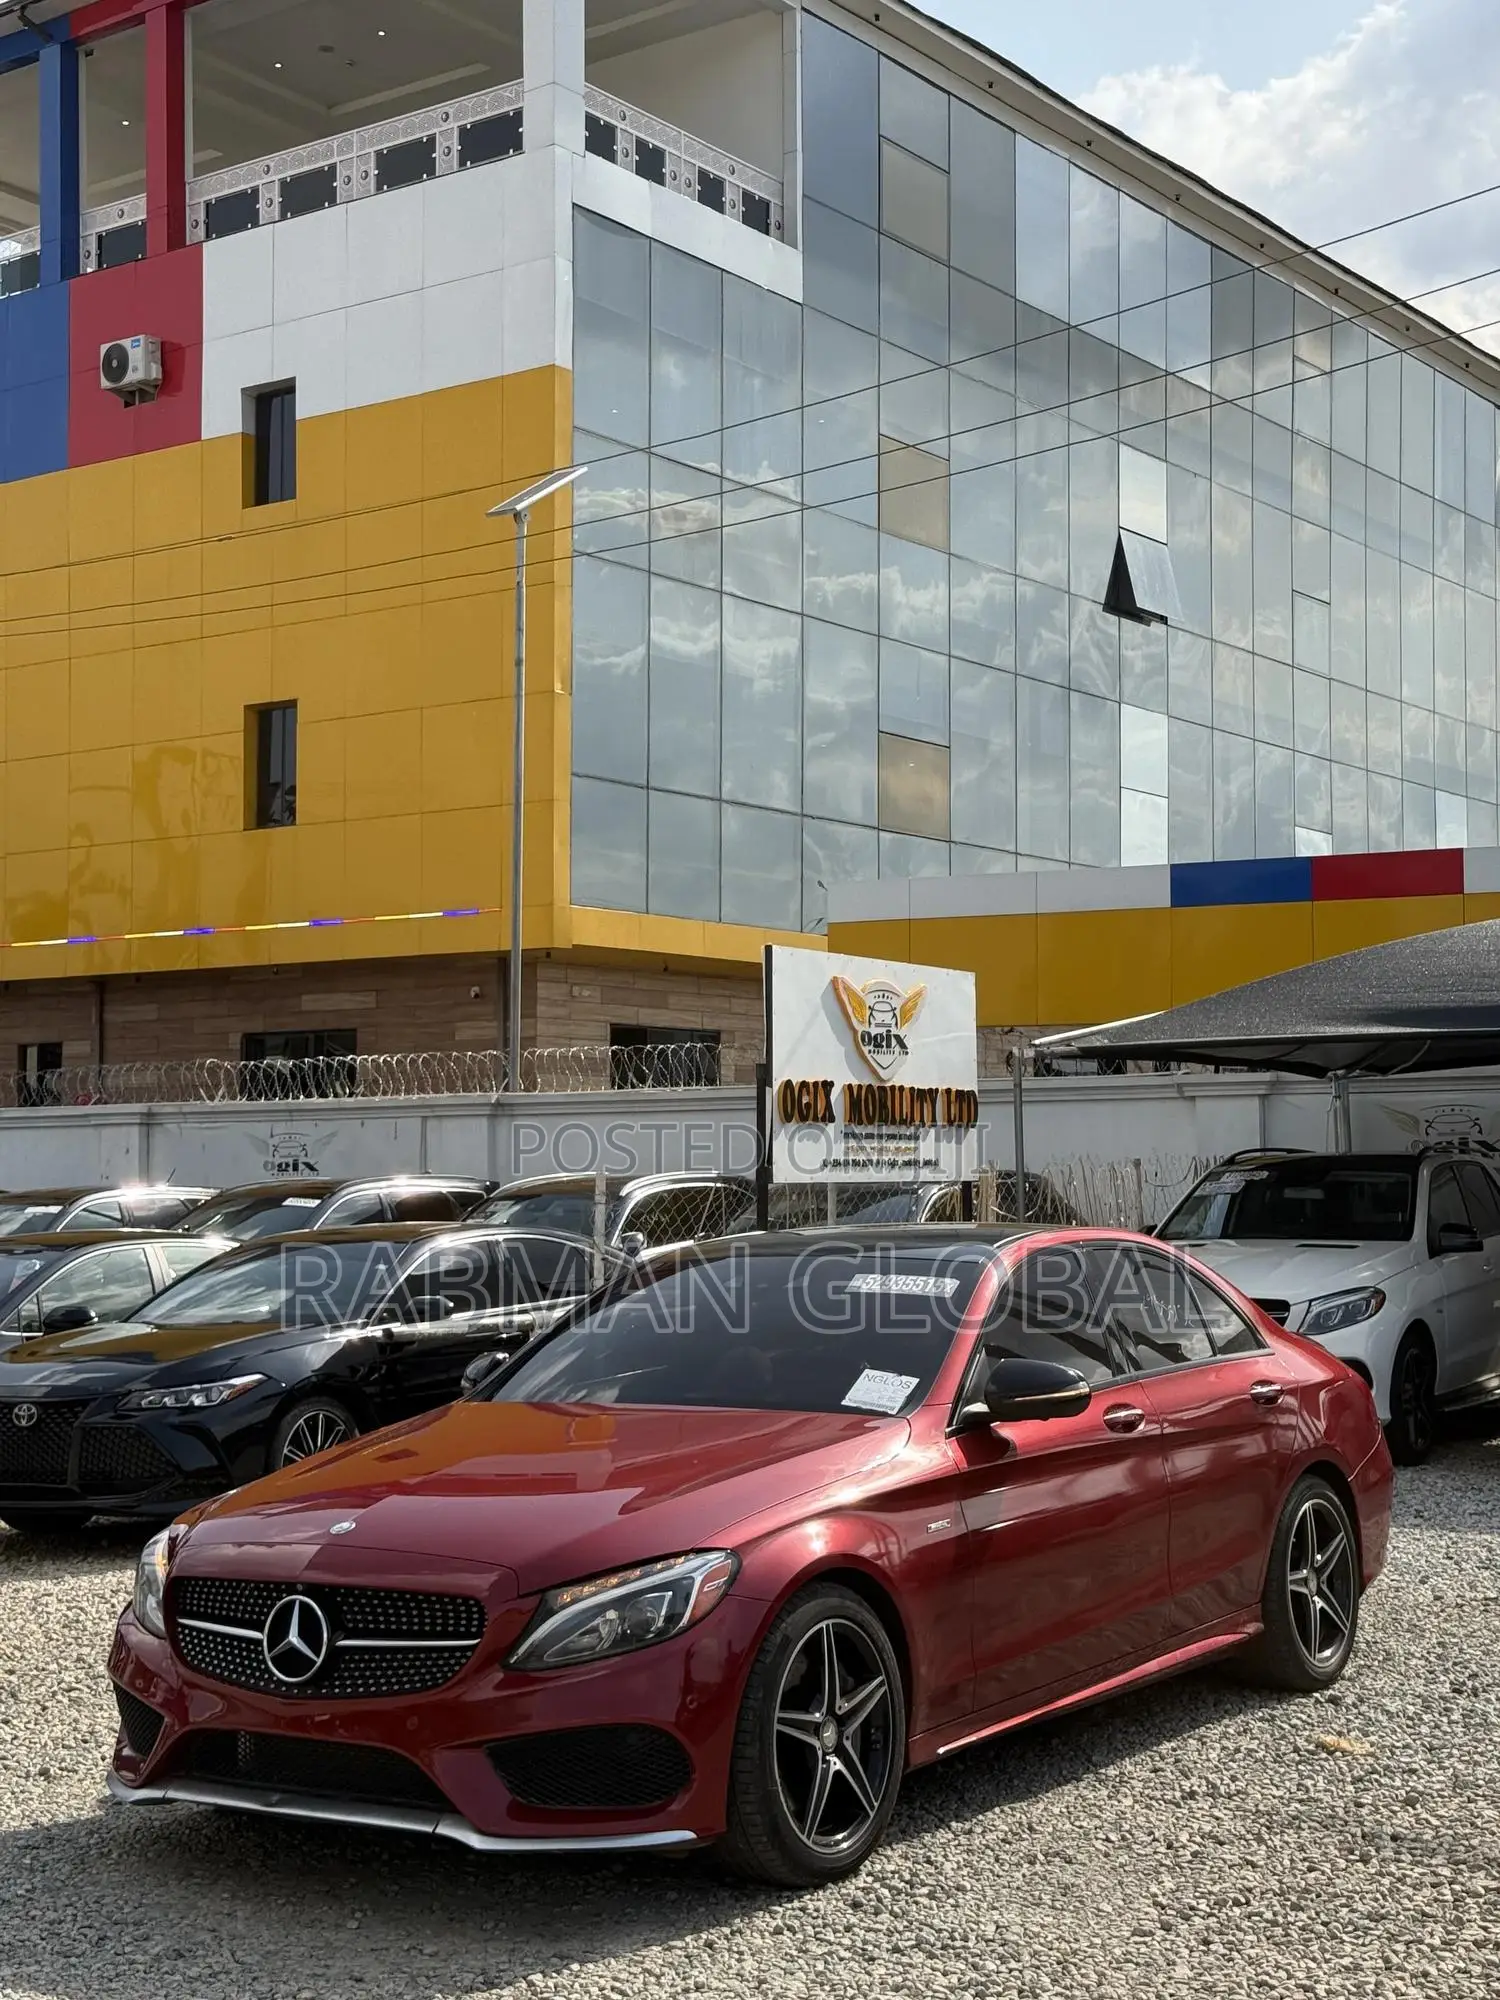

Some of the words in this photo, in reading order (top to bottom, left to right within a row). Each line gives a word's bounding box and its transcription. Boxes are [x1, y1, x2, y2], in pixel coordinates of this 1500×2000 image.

[778, 1079, 836, 1124] OGIX
[843, 1083, 939, 1129] MOBILITY
[940, 1088, 979, 1129] LTD
[863, 1373, 913, 1390] NGLOS
